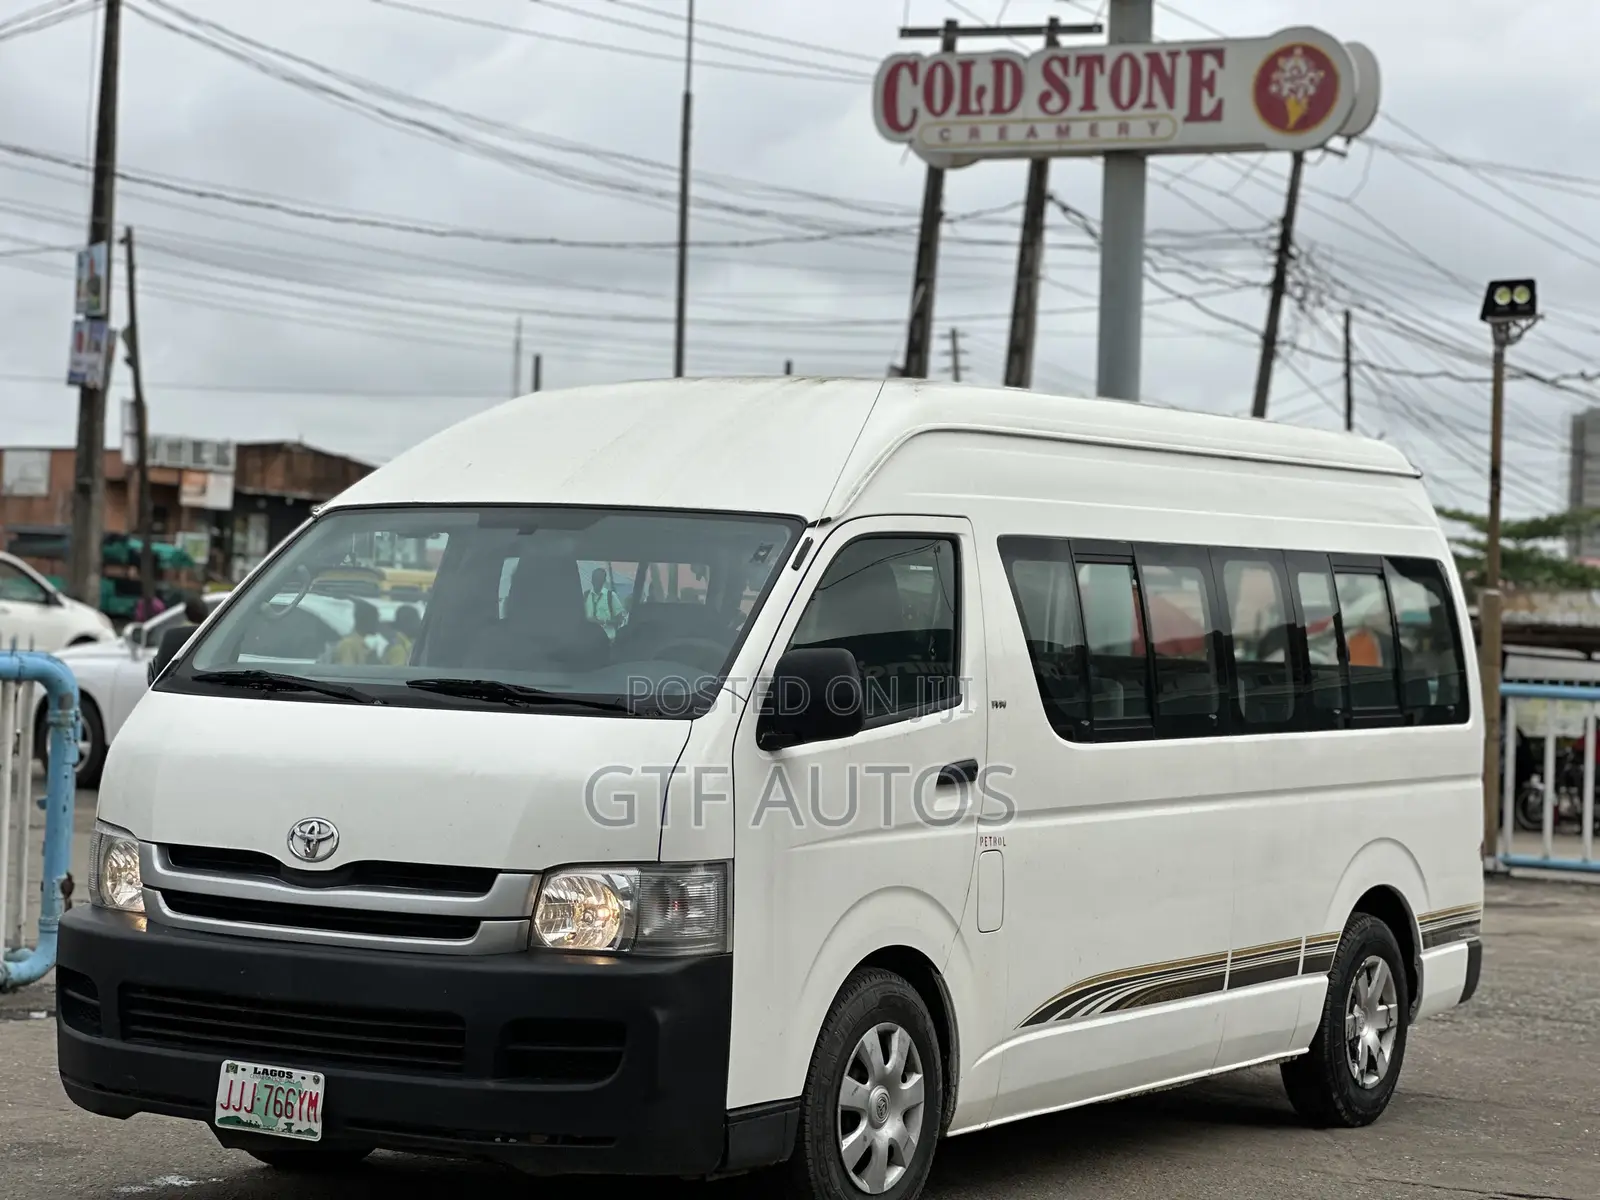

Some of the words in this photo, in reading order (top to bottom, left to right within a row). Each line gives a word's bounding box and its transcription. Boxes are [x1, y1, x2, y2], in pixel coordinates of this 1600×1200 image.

[883, 60, 1024, 133] COLD
[1038, 49, 1225, 123] STONE
[940, 120, 1160, 142] CREAMERY
[979, 836, 1007, 847] PETROL
[253, 1067, 294, 1079] LAGOS
